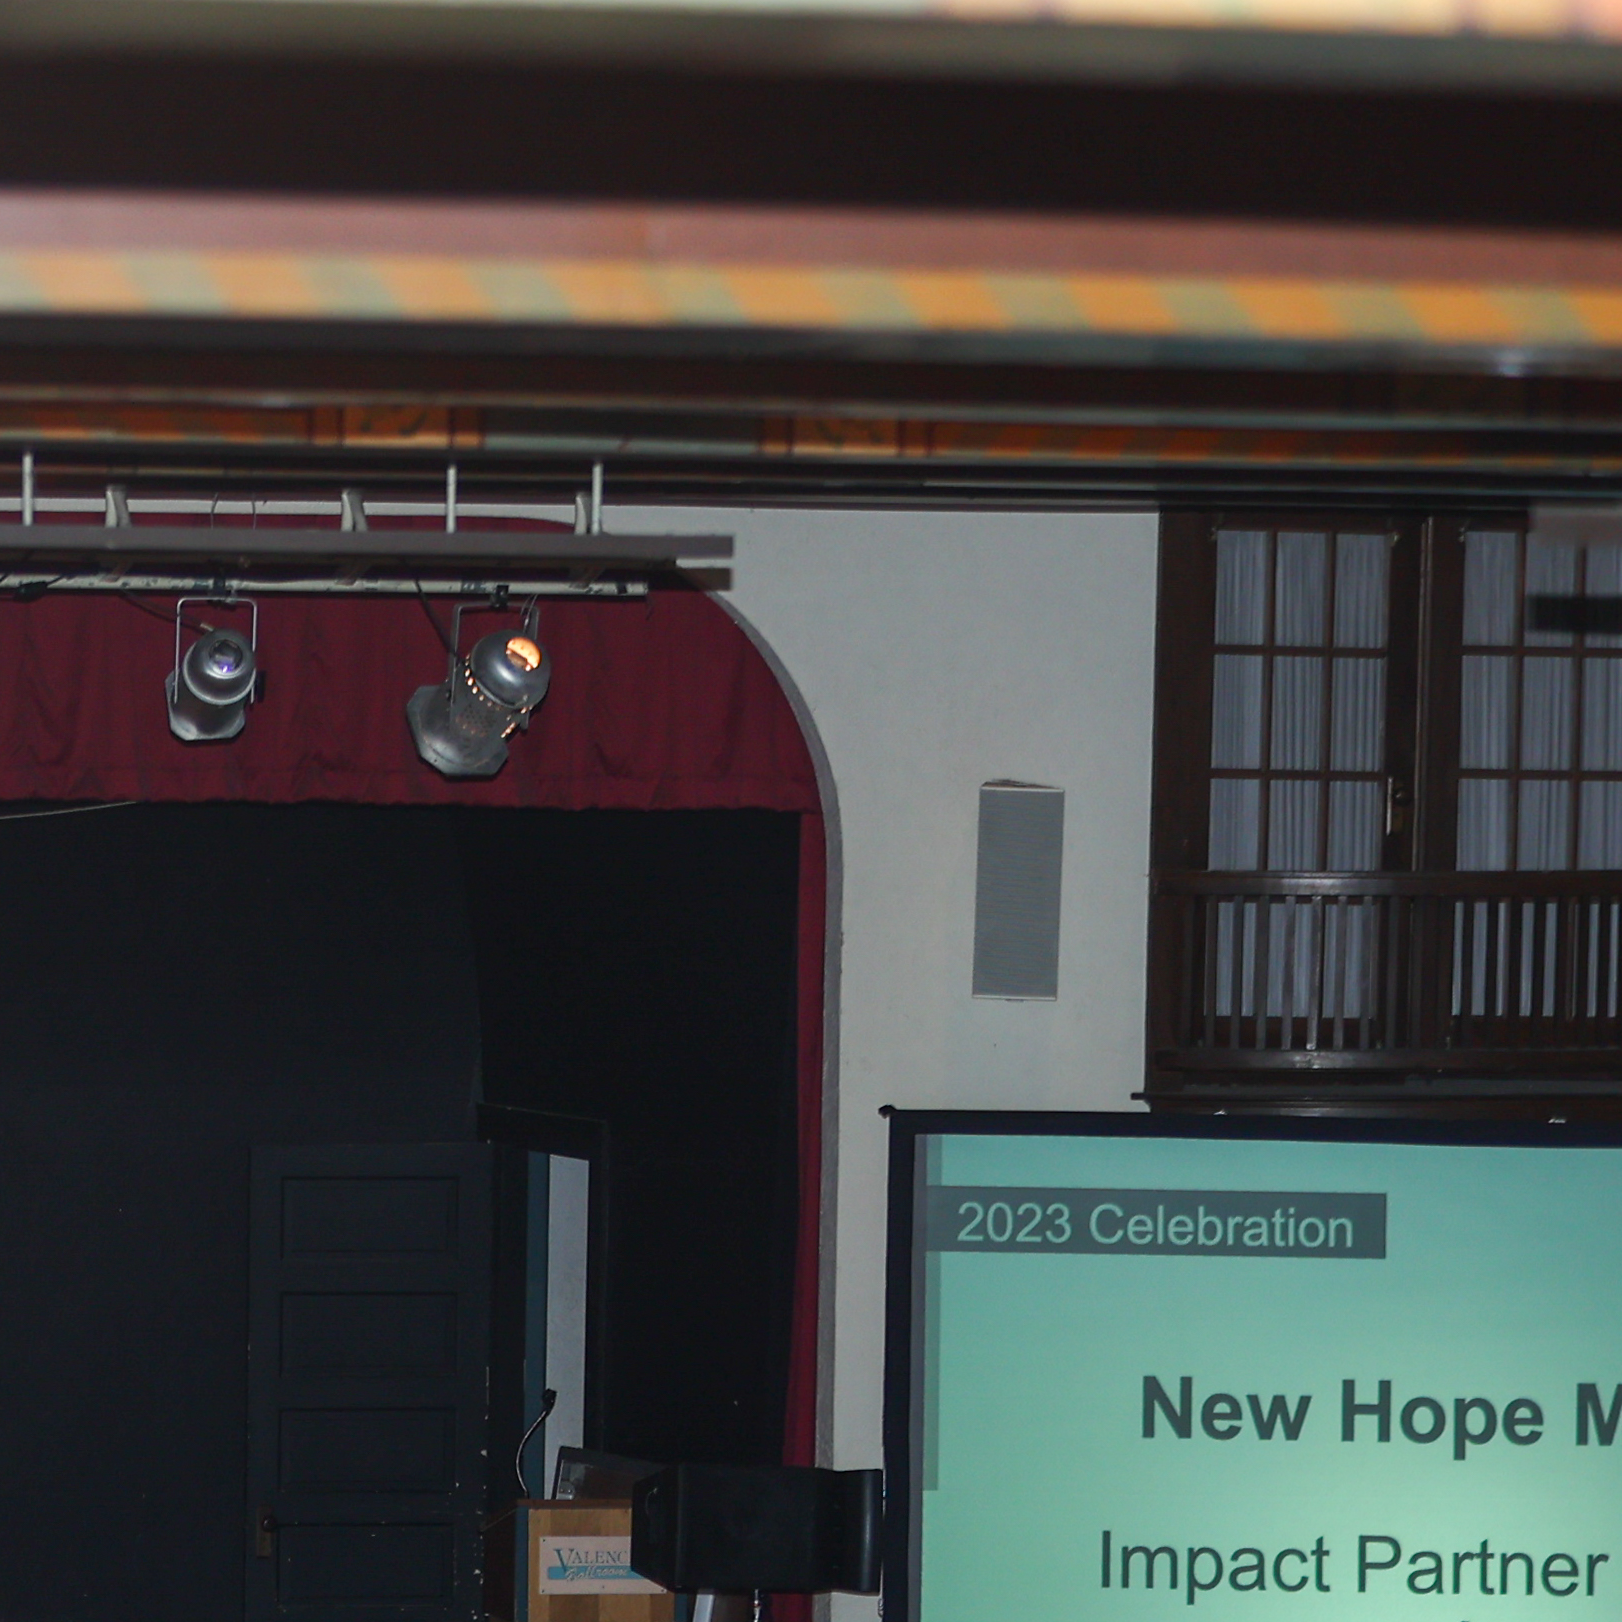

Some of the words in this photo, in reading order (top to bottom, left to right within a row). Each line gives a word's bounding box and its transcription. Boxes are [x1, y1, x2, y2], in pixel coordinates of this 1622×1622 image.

[957, 1200, 1073, 1244] 2023
[1088, 1203, 1355, 1248] Celebration
[1141, 1375, 1312, 1441] New
[1340, 1378, 1544, 1461] Hope
[565, 1565, 628, 1583] Ballroom
[1100, 1530, 1329, 1605] Impact
[1358, 1534, 1608, 1597] Partner
